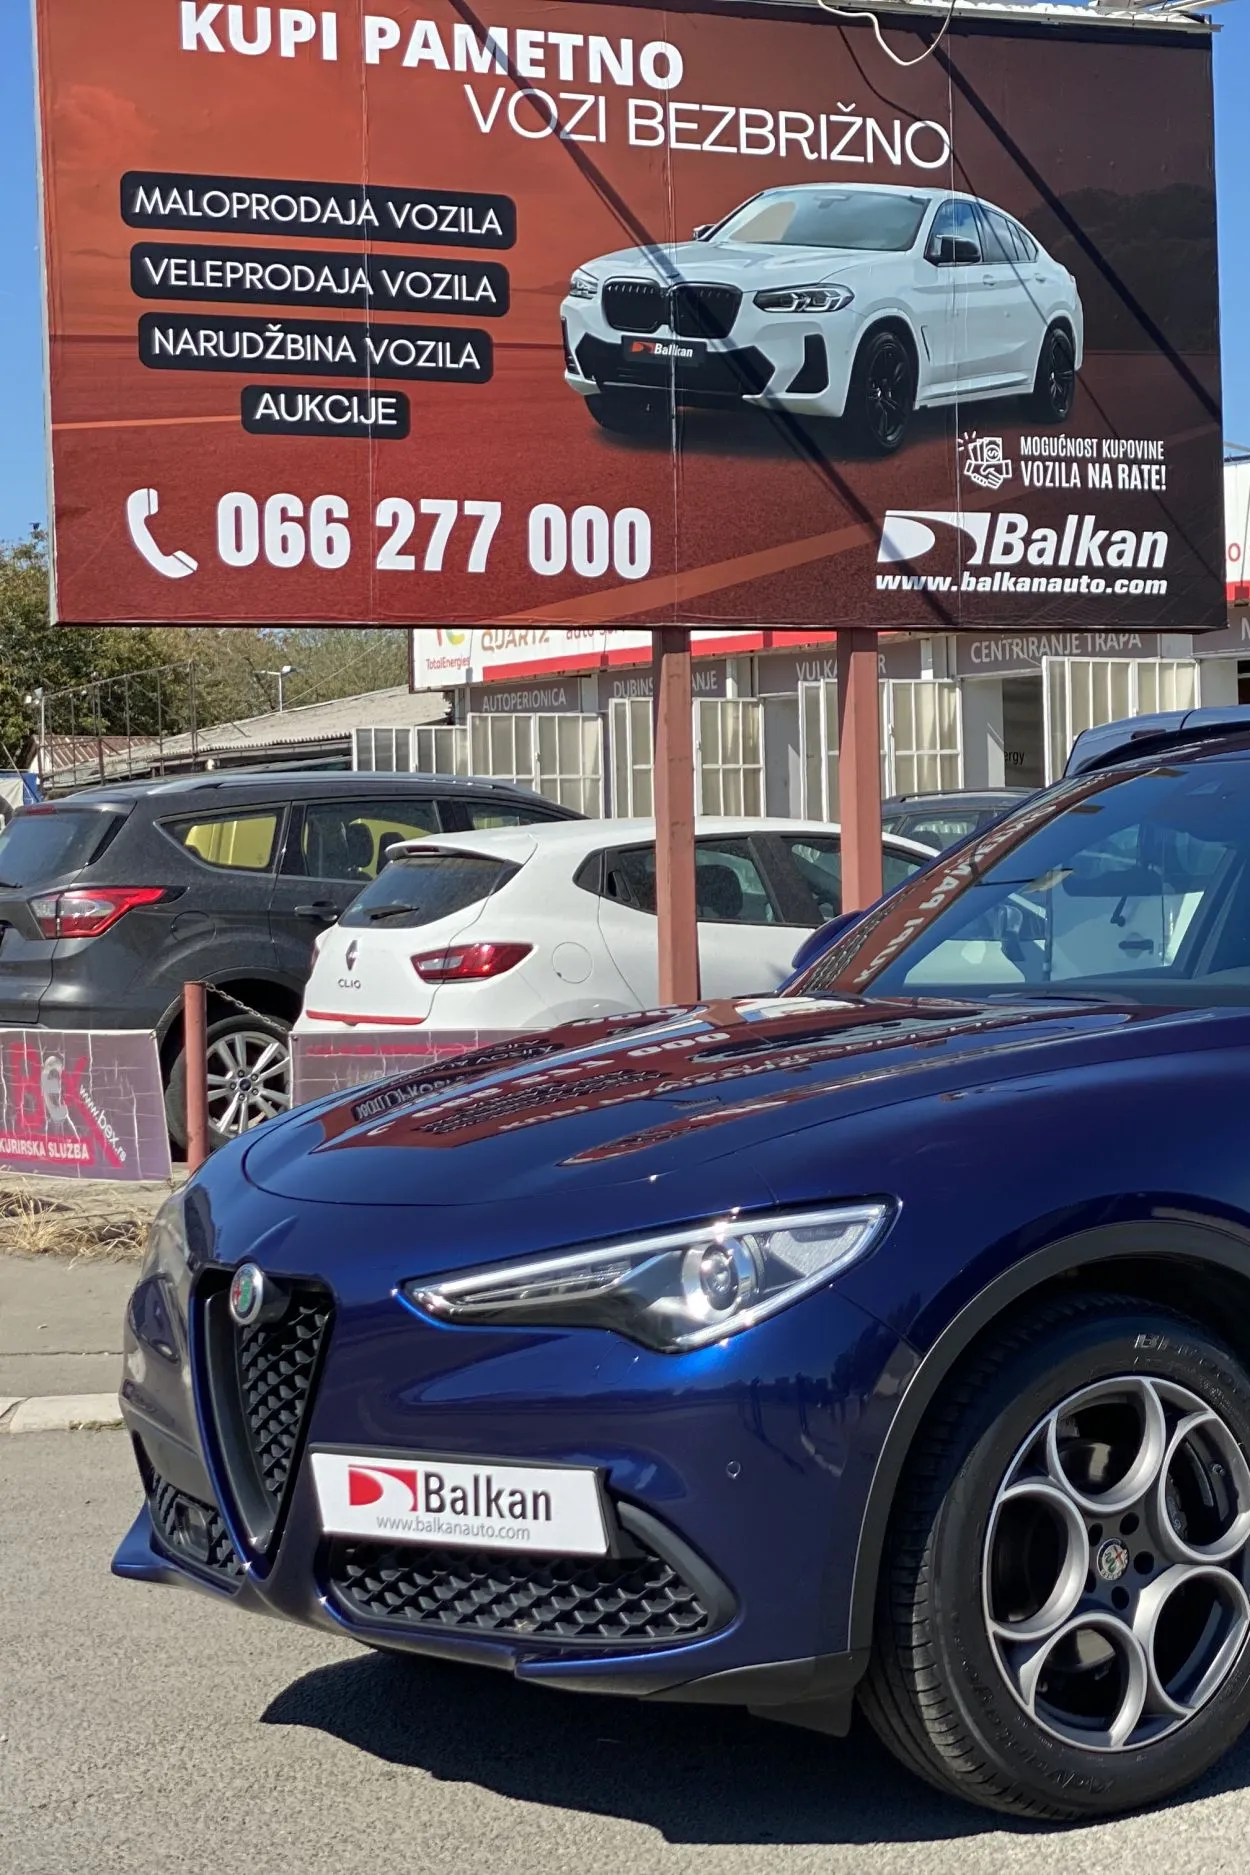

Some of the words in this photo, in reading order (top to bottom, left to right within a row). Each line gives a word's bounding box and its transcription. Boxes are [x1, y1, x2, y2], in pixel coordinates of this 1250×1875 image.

[180, 1, 337, 61] KUPI
[364, 15, 684, 90] PAMETNO
[464, 84, 607, 143] VOZI
[628, 98, 951, 169] BEZBRIŽNO
[134, 185, 379, 227] MALOPRODAJA
[388, 201, 503, 236] VOZILA
[144, 256, 374, 295] VELEPRODAJA
[381, 269, 497, 303] VOZILA
[153, 323, 357, 363] NARUDŽBINA
[366, 337, 481, 370] VOZILA
[654, 342, 694, 358] Balkan
[254, 392, 398, 426] AUKCIJE
[1020, 434, 1098, 458] MOGUĆNOST
[1102, 439, 1165, 460] KUPOVINE
[1020, 460, 1081, 488] VOZILA
[1088, 462, 1113, 490] NA
[1117, 463, 1167, 491] RATE!
[216, 491, 351, 570] 066
[375, 496, 502, 573] 277
[527, 502, 652, 580] 000
[988, 512, 1169, 569] Balkan
[875, 571, 1168, 595] www.balkanauto.com
[426, 655, 471, 671] TotalEnergies
[971, 633, 1081, 663] CENTRIRANJE
[1083, 633, 1142, 653] TRAPA
[482, 687, 567, 712] AUTOPERIONICA
[338, 979, 361, 989] CLIO
[48, 1139, 89, 1160] SLUŽBA
[423, 1471, 552, 1521] Balkan
[376, 1515, 530, 1541] www.balkanauto.com
